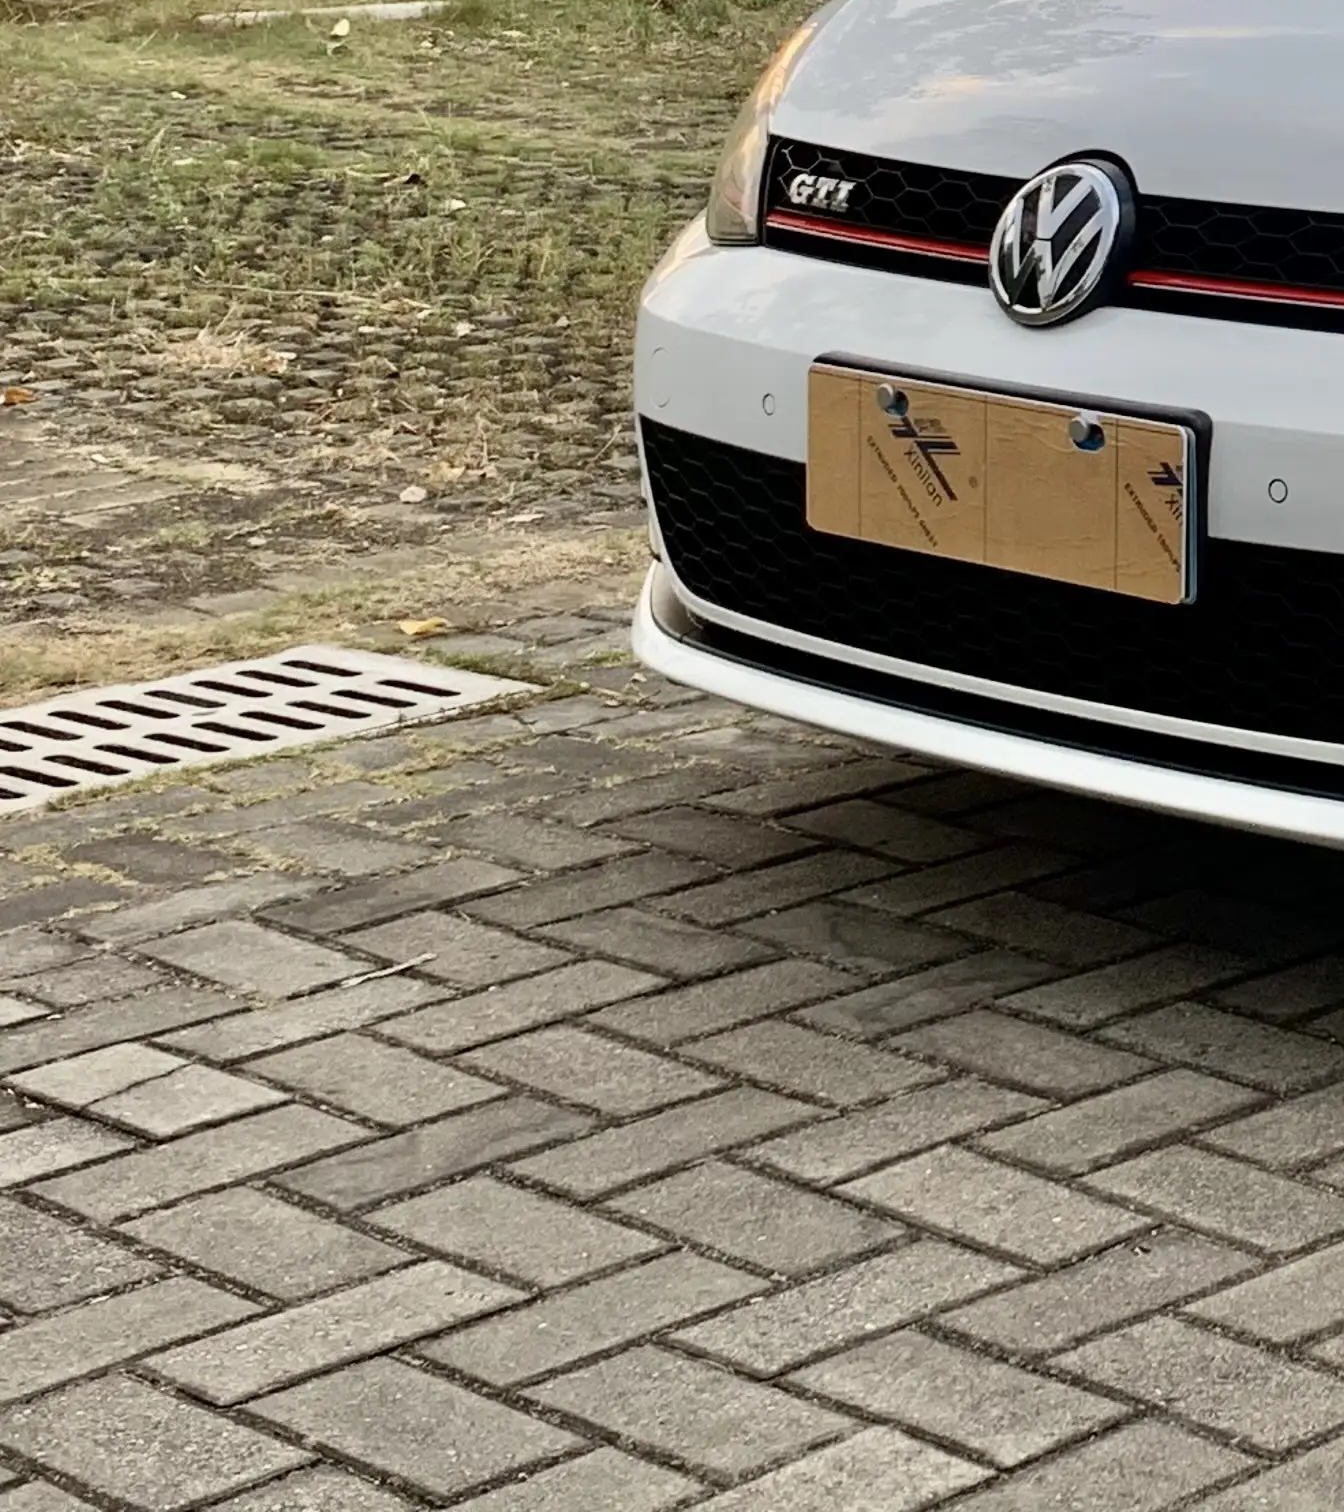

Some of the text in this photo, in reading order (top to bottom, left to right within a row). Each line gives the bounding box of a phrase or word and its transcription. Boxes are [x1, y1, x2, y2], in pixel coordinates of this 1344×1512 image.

[789, 173, 857, 213] GTI
[998, 170, 1110, 314] VW
[1124, 482, 1158, 533] EXTRUDED
